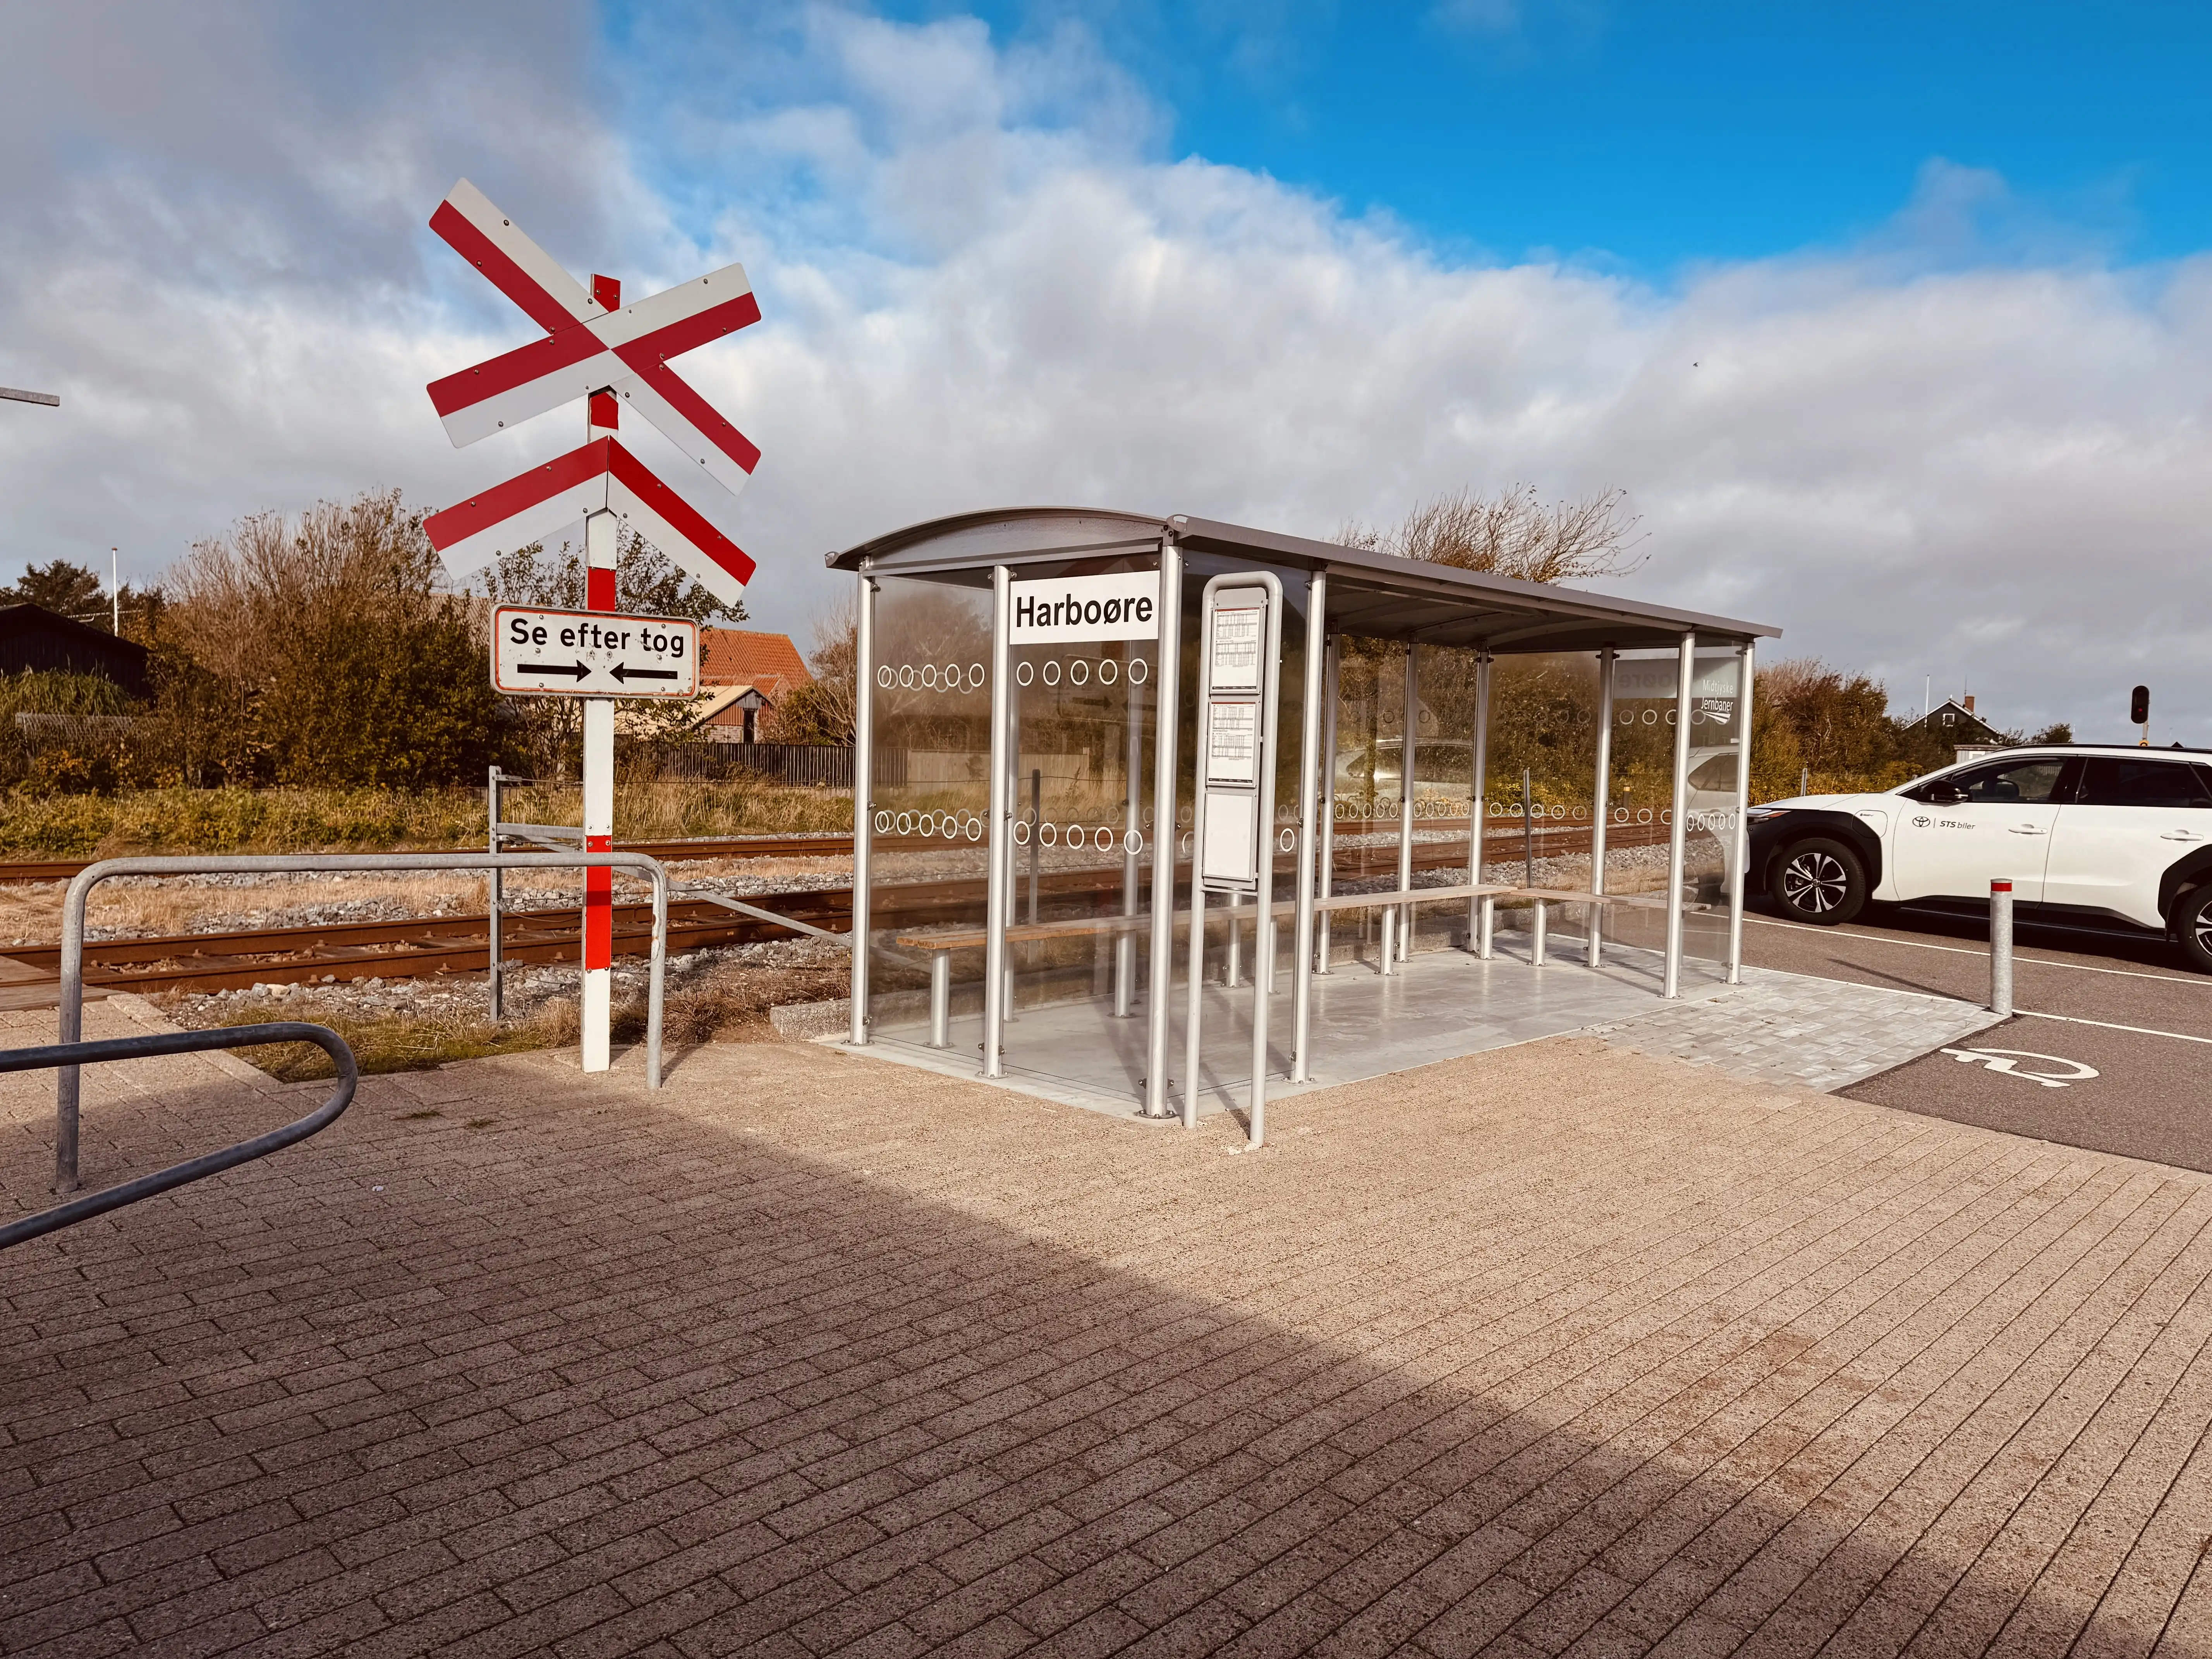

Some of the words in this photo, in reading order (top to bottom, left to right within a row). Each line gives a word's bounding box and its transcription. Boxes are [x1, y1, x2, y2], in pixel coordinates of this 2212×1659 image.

[1016, 593, 1153, 628] Harboøre
[510, 618, 548, 646] Se
[560, 622, 631, 650] efter
[640, 627, 684, 658] tog
[1702, 679, 1733, 696] Midtjyske
[1701, 696, 1733, 711] Jernbaner
